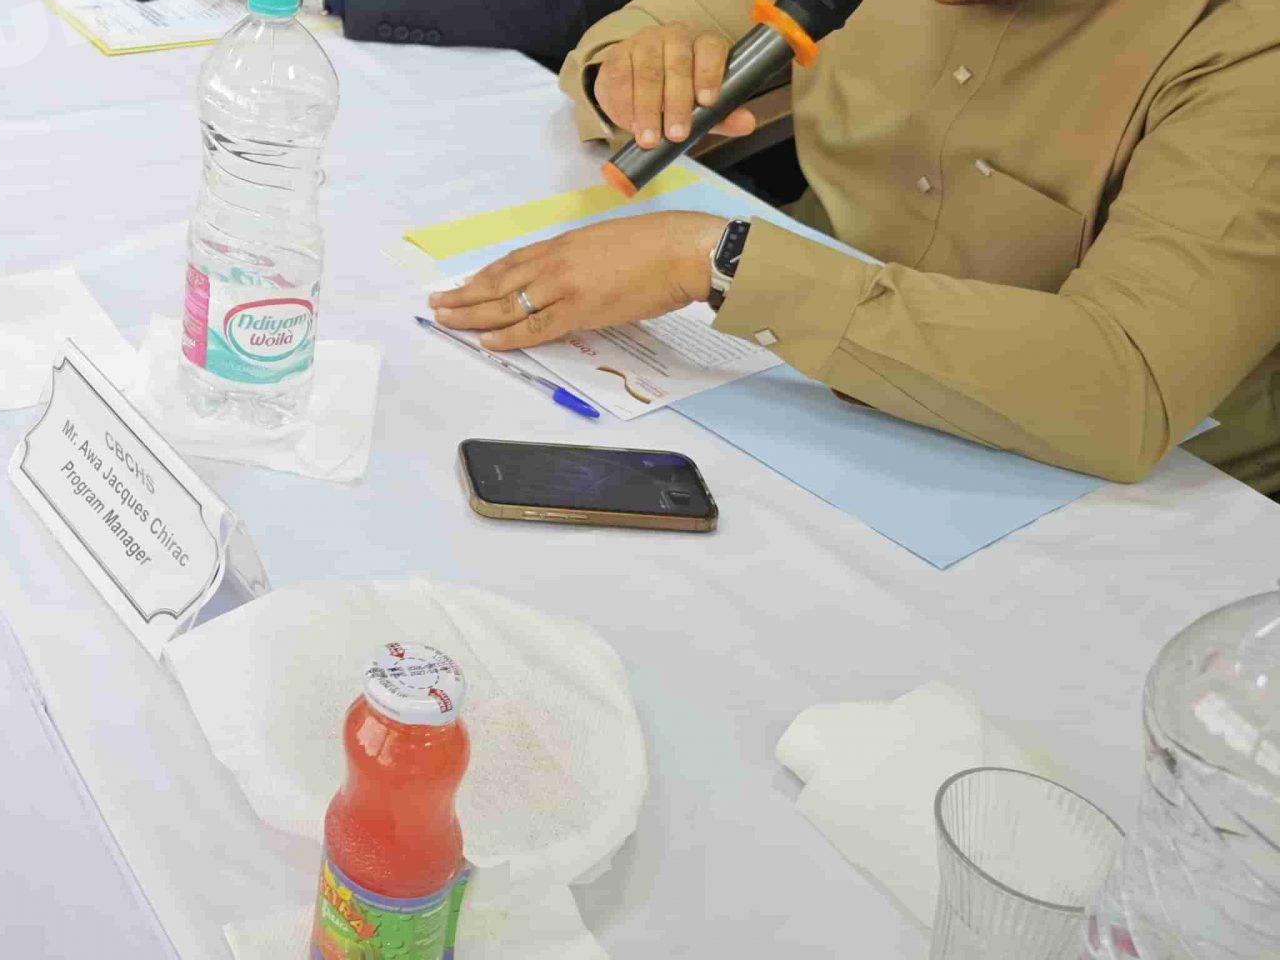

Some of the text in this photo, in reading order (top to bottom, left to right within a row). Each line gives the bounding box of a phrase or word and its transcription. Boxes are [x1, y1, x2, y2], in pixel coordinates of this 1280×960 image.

[60, 418, 191, 569] Mr. Awa Jacques Chirac
[60, 460, 153, 568] Program Manager
[104, 430, 156, 495] CBCHS
